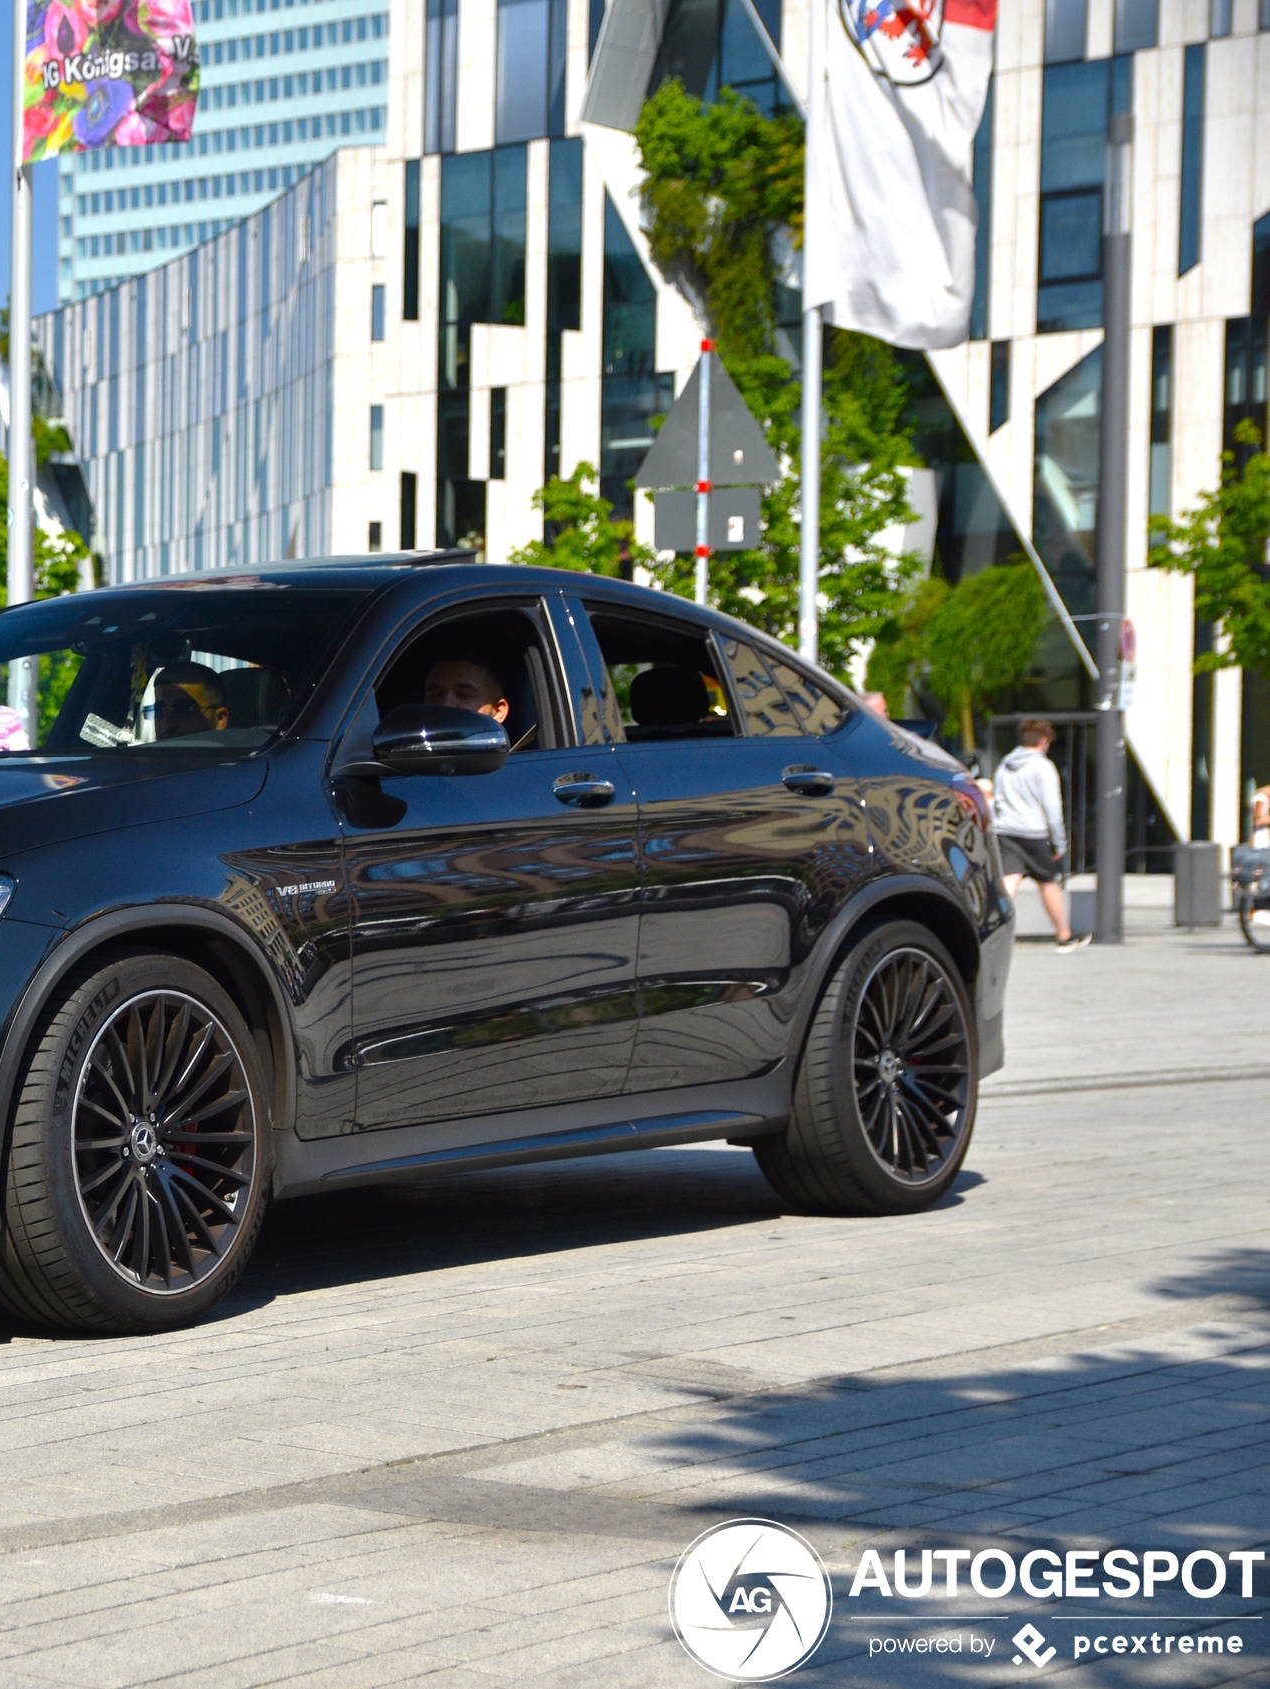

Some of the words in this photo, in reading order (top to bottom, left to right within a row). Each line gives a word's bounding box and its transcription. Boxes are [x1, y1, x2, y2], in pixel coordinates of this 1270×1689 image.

[64, 49, 163, 84] Königsa
[276, 884, 298, 897] V8
[60, 978, 119, 1084] MICHELIN
